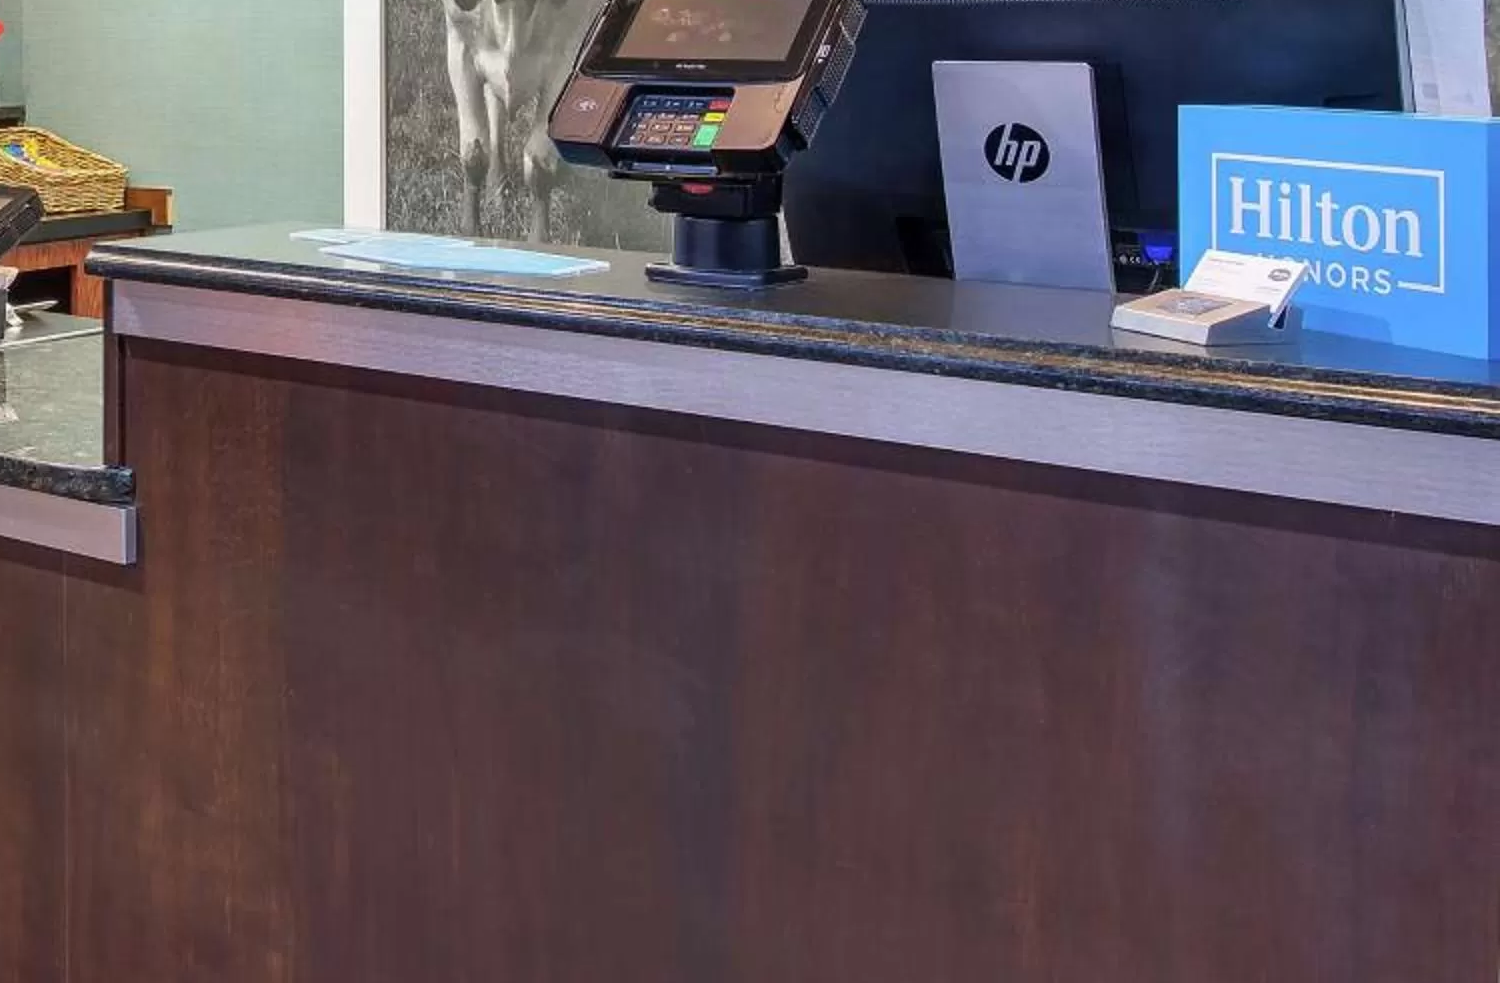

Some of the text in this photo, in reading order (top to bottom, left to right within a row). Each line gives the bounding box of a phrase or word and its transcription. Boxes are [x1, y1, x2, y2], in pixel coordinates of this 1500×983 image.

[991, 122, 1043, 182] hp
[1228, 176, 1424, 258] Hilton
[1257, 253, 1393, 296] NORS
